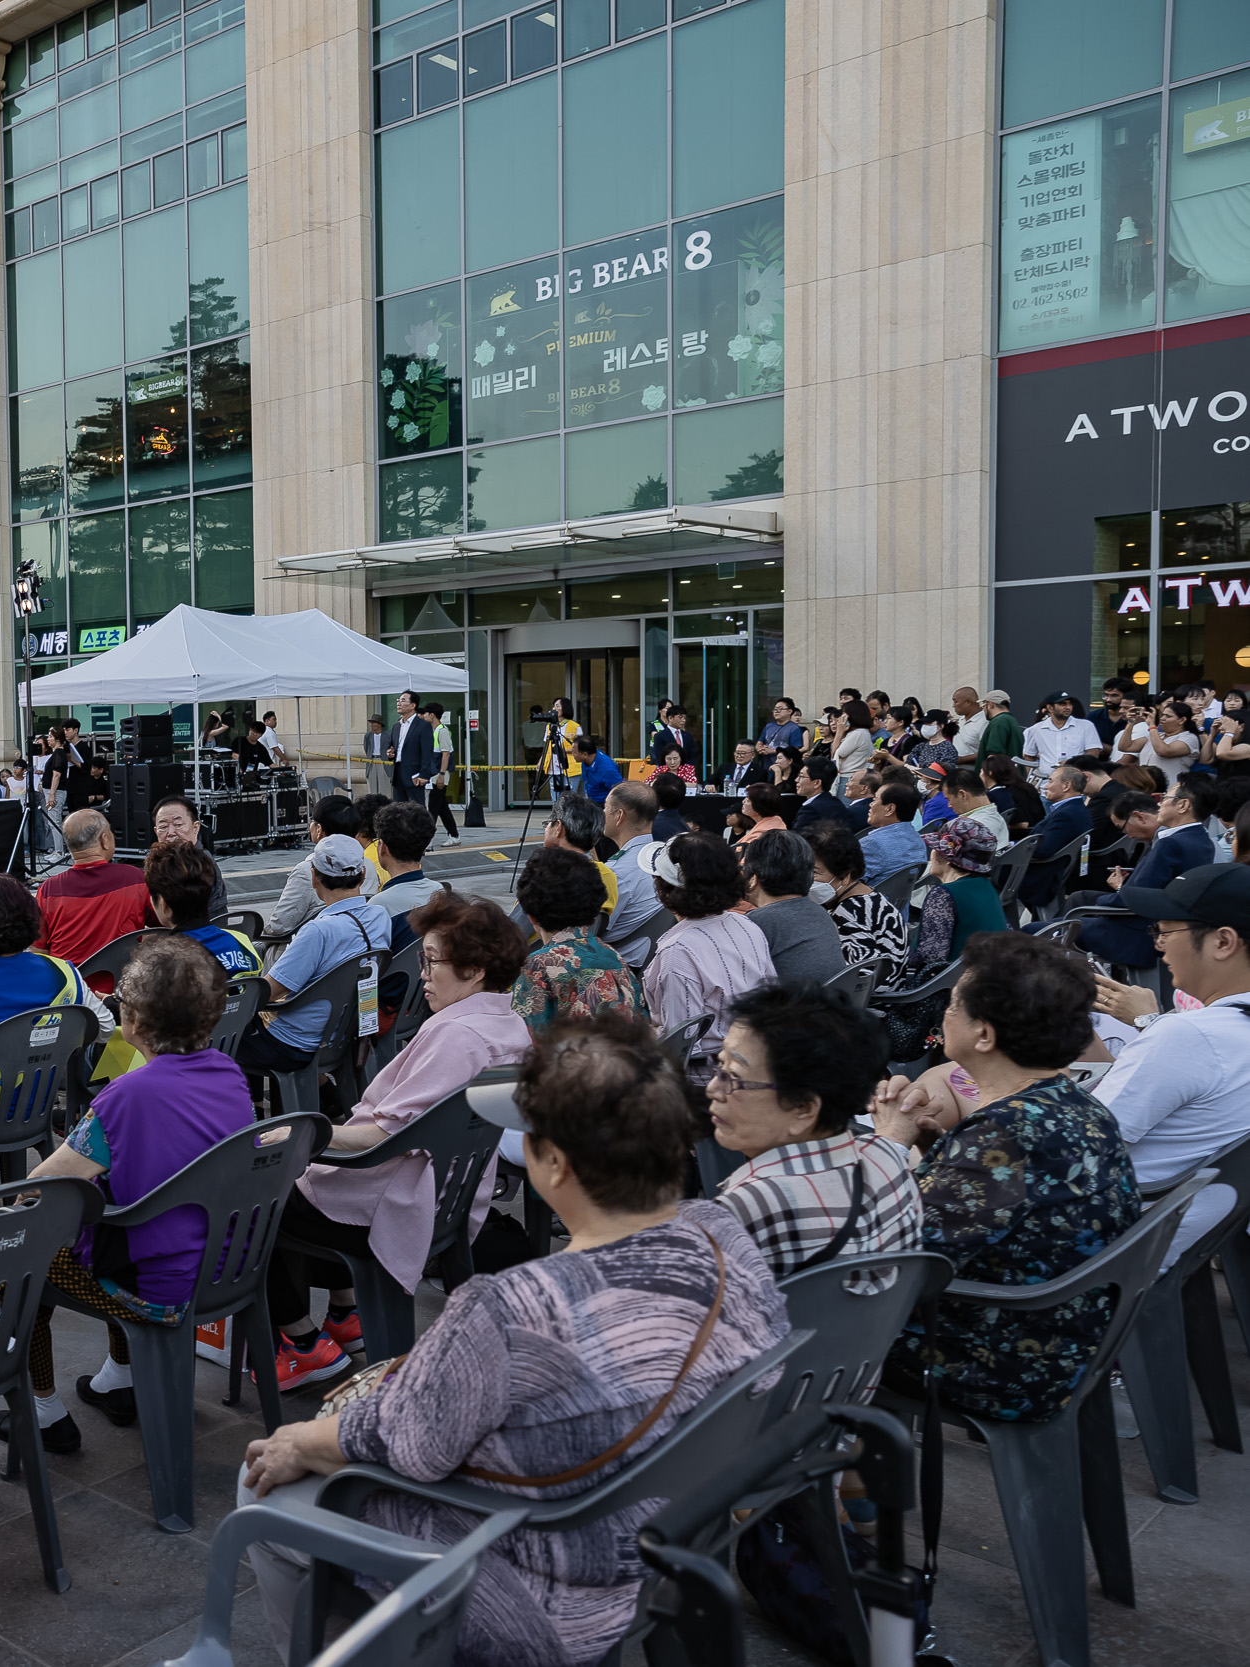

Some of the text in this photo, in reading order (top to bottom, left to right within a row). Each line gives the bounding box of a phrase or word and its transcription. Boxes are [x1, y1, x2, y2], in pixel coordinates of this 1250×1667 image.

[1028, 142, 1075, 165] 돌잔치
[1017, 161, 1086, 188] 스몰웨딩
[1020, 183, 1083, 208] 기업연회
[1018, 204, 1086, 230] 맞춤파티
[1020, 237, 1083, 262] 출장파티
[535, 230, 713, 302] BIG BEAR 8
[1014, 255, 1091, 282] 단체도시락
[1012, 287, 1088, 310] 02.462.8802
[603, 330, 709, 374] 레스토랑
[39, 631, 68, 654] 세종
[83, 629, 120, 648] 스포츠
